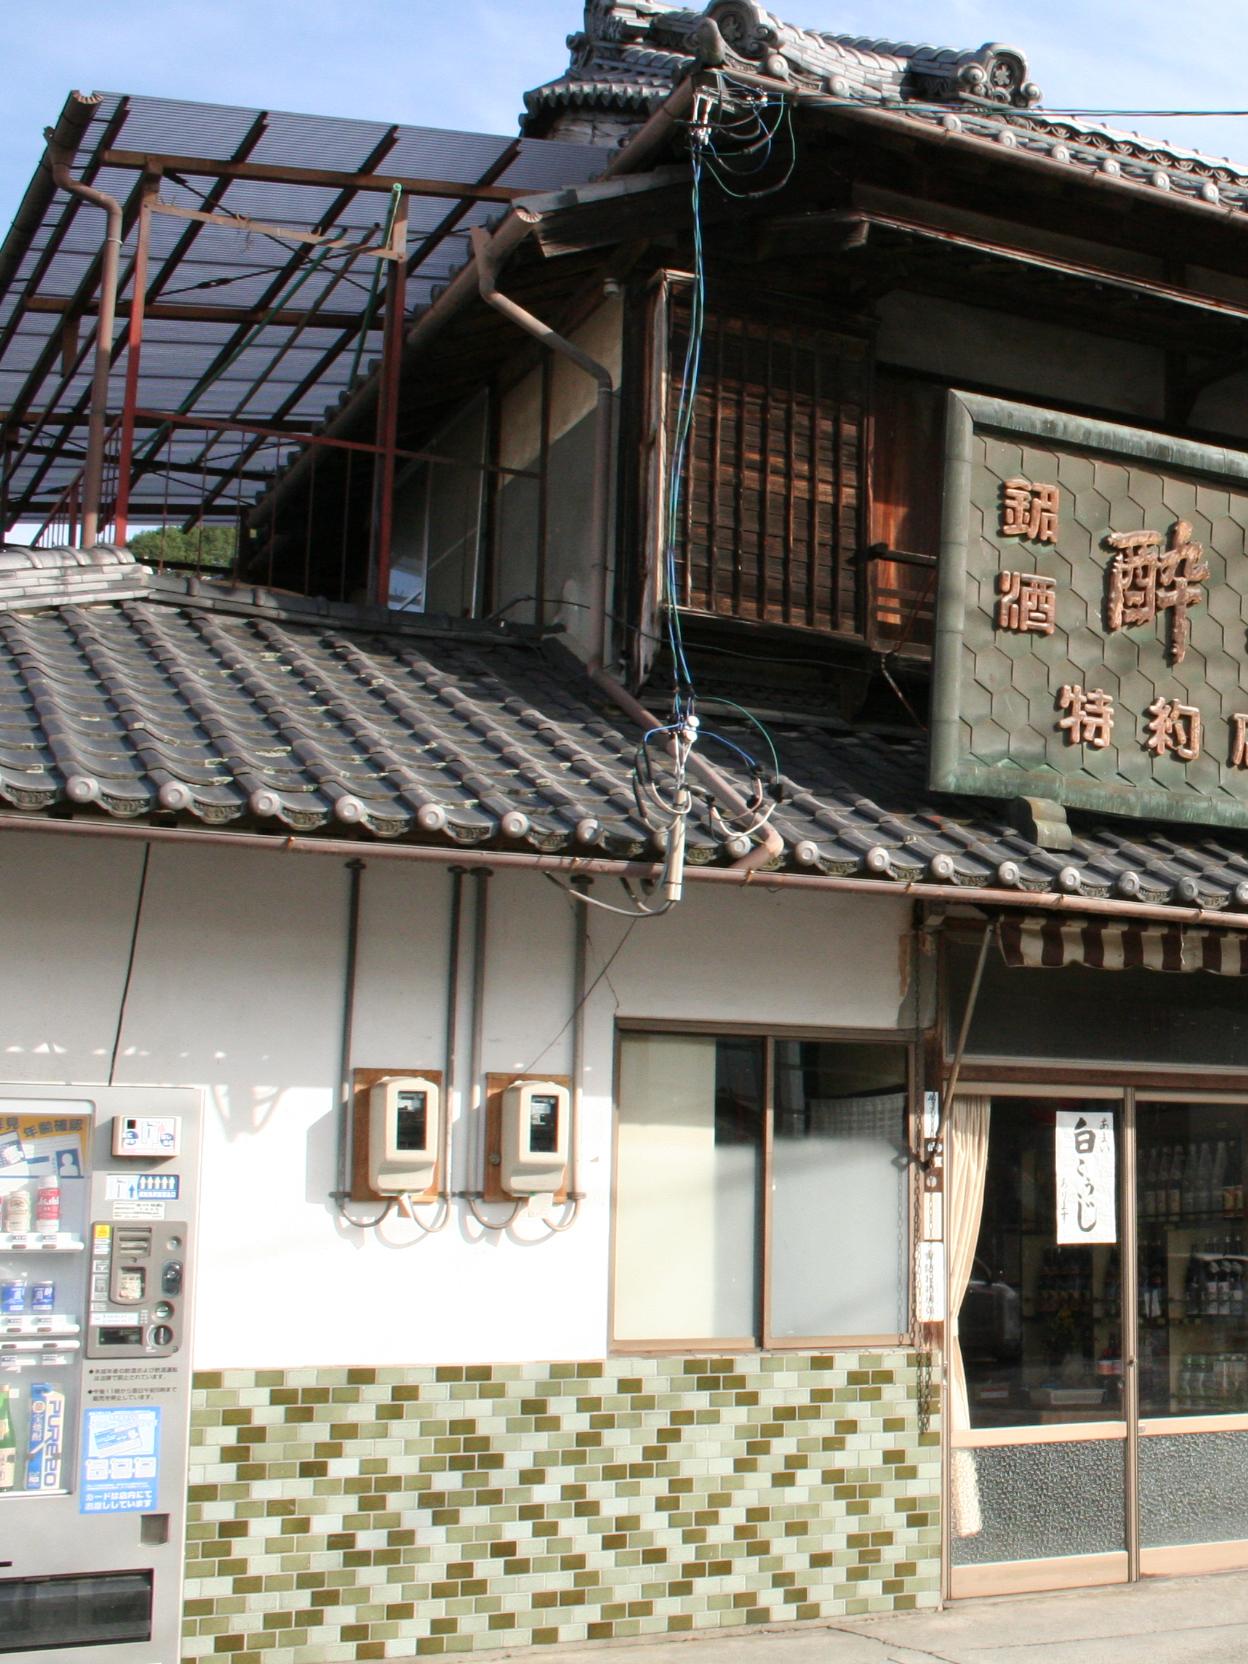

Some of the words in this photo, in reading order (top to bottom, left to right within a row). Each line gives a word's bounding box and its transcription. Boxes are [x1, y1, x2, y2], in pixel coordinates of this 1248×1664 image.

[1000, 478, 1060, 636] 銘酒
[1074, 1116, 1098, 1233] 白こうじ
